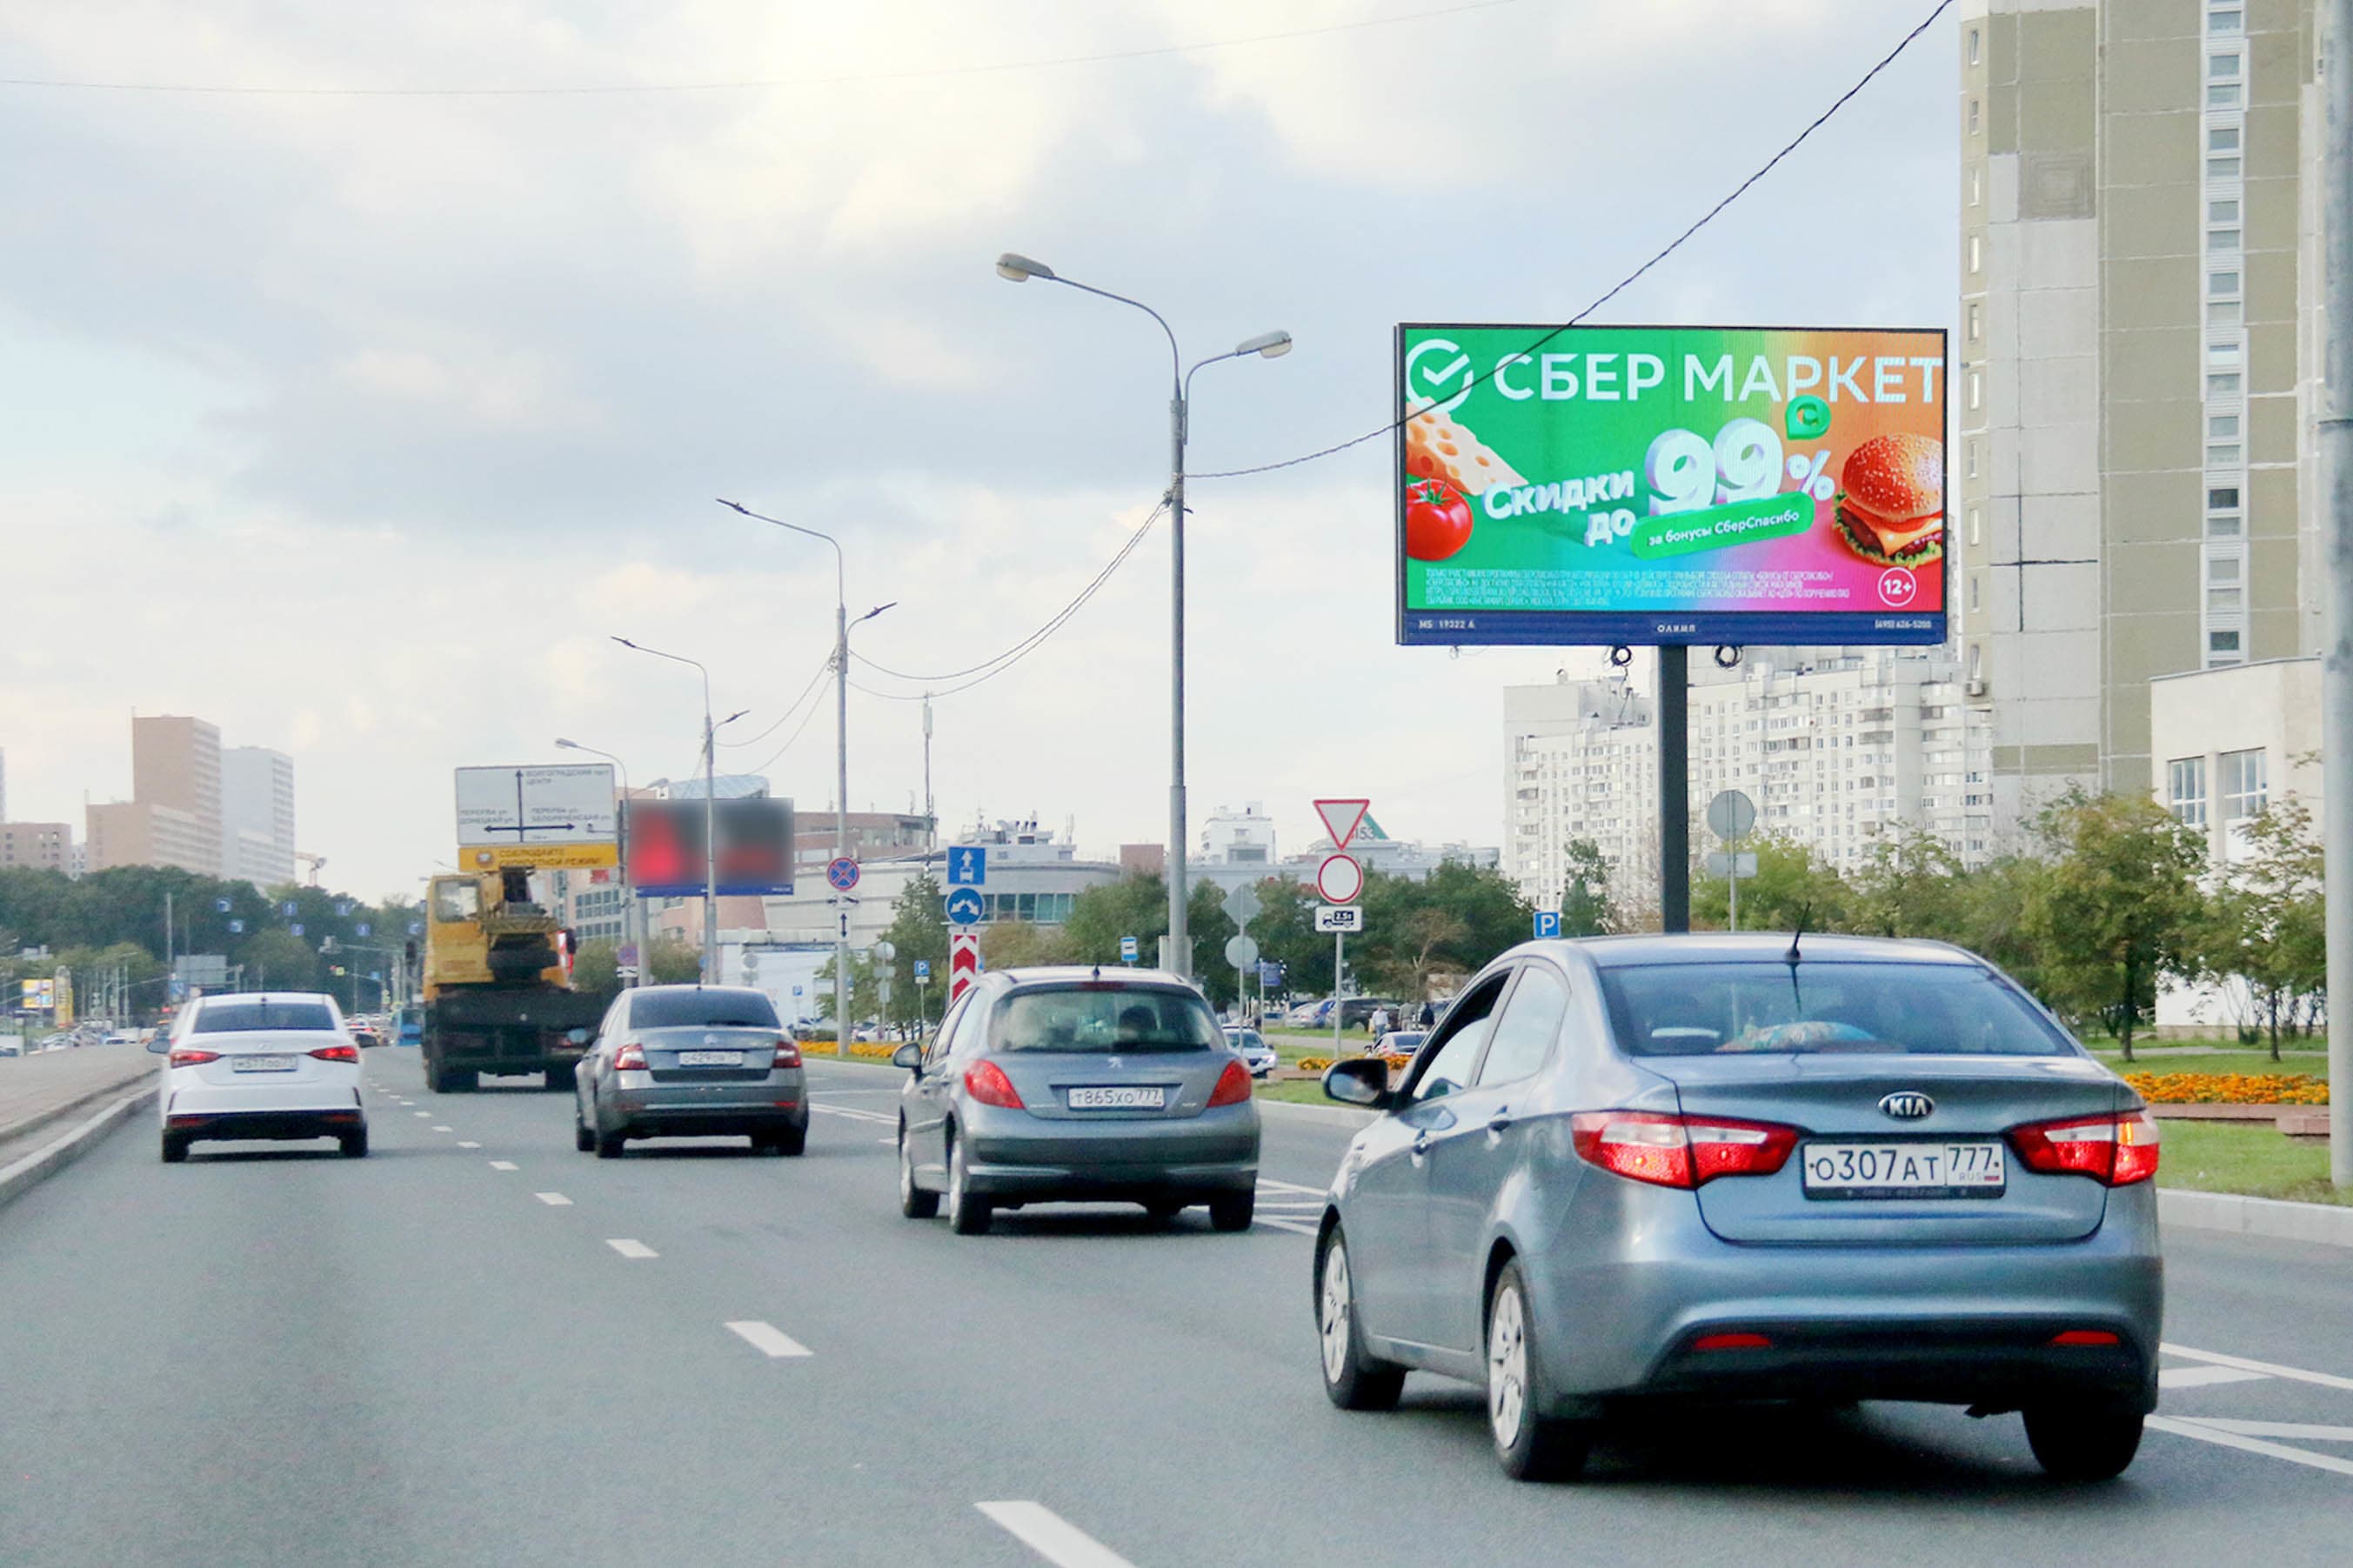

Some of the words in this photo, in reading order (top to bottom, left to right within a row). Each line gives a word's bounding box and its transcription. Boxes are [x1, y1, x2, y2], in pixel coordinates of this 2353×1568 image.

[1494, 352, 1665, 401] СБЕР
[1684, 354, 1943, 403] МАРКЕТ
[1482, 470, 1635, 519] Скидки
[1584, 509, 1637, 547] до
[1648, 535, 1662, 546] за
[1665, 525, 1712, 541] бонусы
[1715, 510, 1800, 533] СберСпасибо
[1884, 578, 1912, 595] 12+
[1657, 624, 1695, 633] ОЛИМП
[1541, 915, 1555, 935] P
[1075, 1090, 1134, 1104] Т865ХО
[1137, 1089, 1159, 1100] 777
[1888, 1098, 1928, 1116] KIA
[1815, 1149, 1939, 1181] О307АТ
[1948, 1146, 1993, 1171] 777
[1959, 1173, 1983, 1182] RUS
